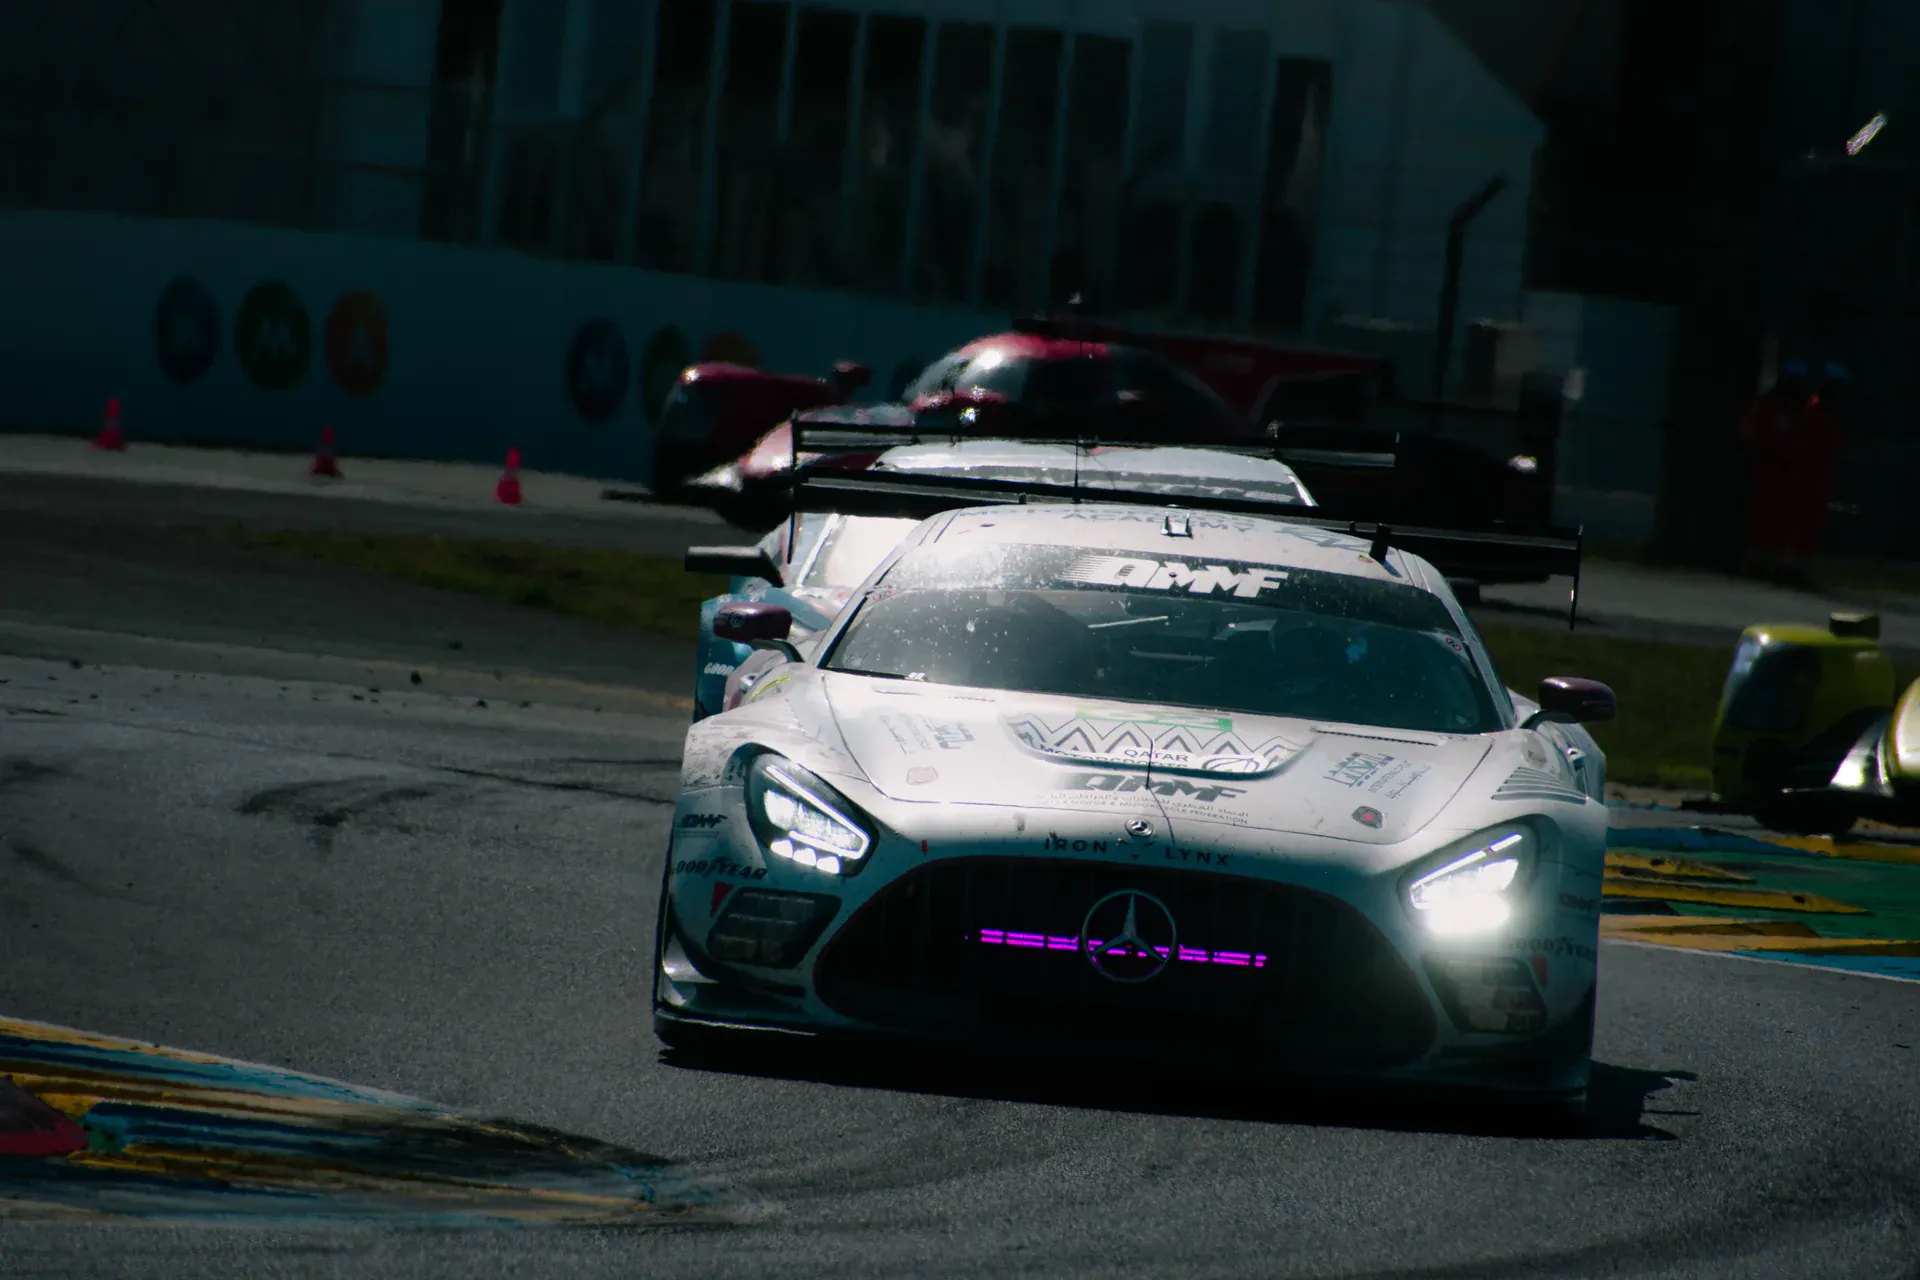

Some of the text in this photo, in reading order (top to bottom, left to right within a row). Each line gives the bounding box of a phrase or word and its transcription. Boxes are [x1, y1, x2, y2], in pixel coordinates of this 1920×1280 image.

[1124, 749, 1189, 763] QATAR
[1189, 809, 1248, 826] FEDERATION
[1045, 838, 1228, 866] IRON LYNX
[674, 857, 768, 880] OODYEAR
